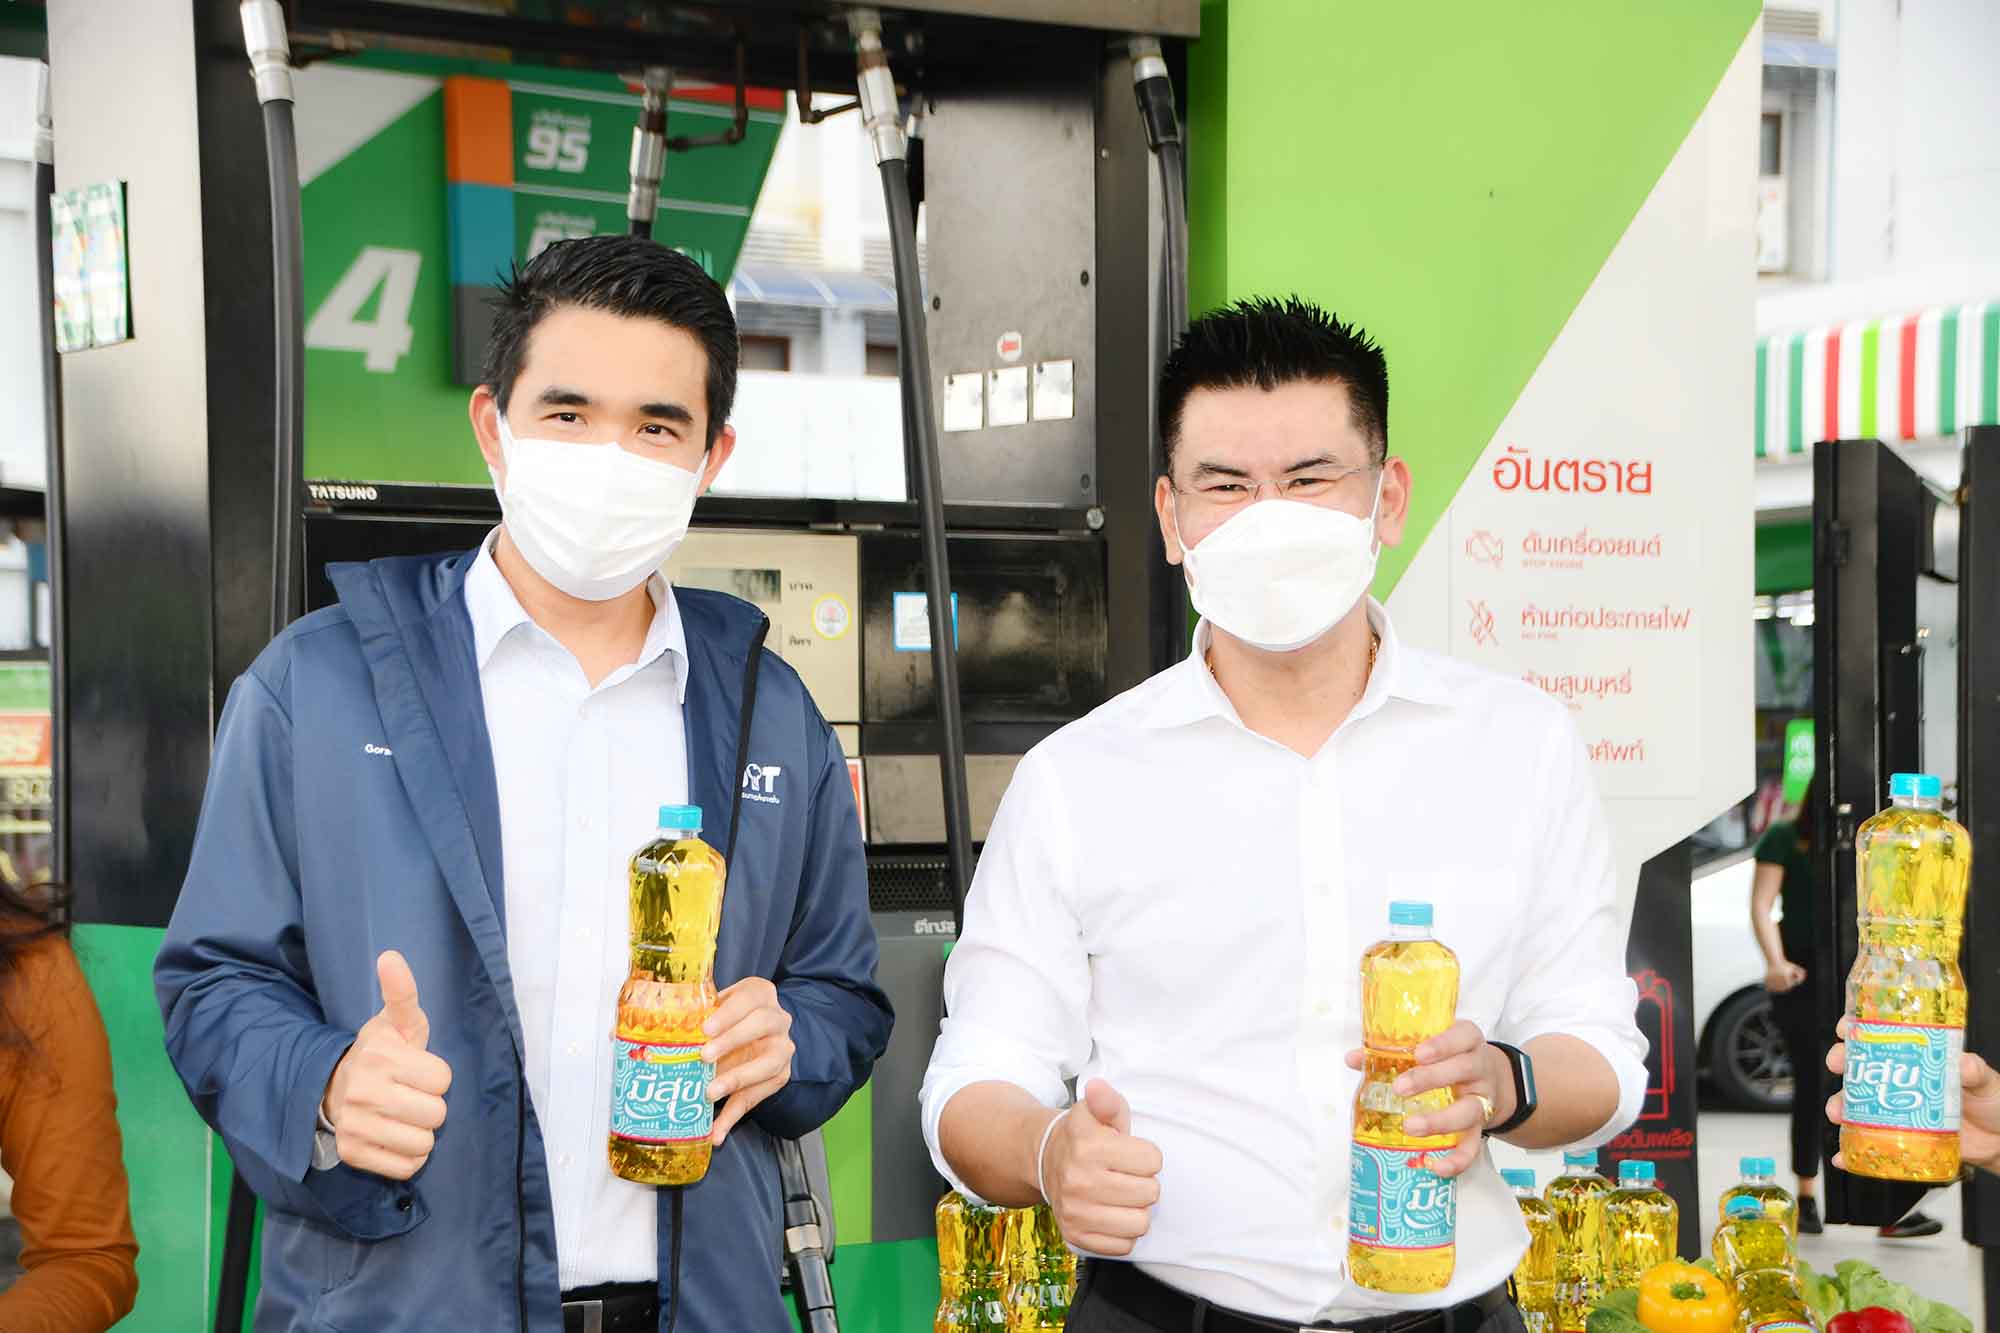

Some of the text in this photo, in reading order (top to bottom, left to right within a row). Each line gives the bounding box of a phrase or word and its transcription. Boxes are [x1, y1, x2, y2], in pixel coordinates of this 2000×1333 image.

[304, 246, 423, 374] 4
[1493, 445, 1653, 495] อันตราย
[308, 484, 379, 501] TATSUNO
[1521, 526, 1663, 558] ดับเครื่องยนต์
[1521, 603, 1692, 631] ห้ามก่อประกายไฟ
[625, 1072, 704, 1124] มีสุข
